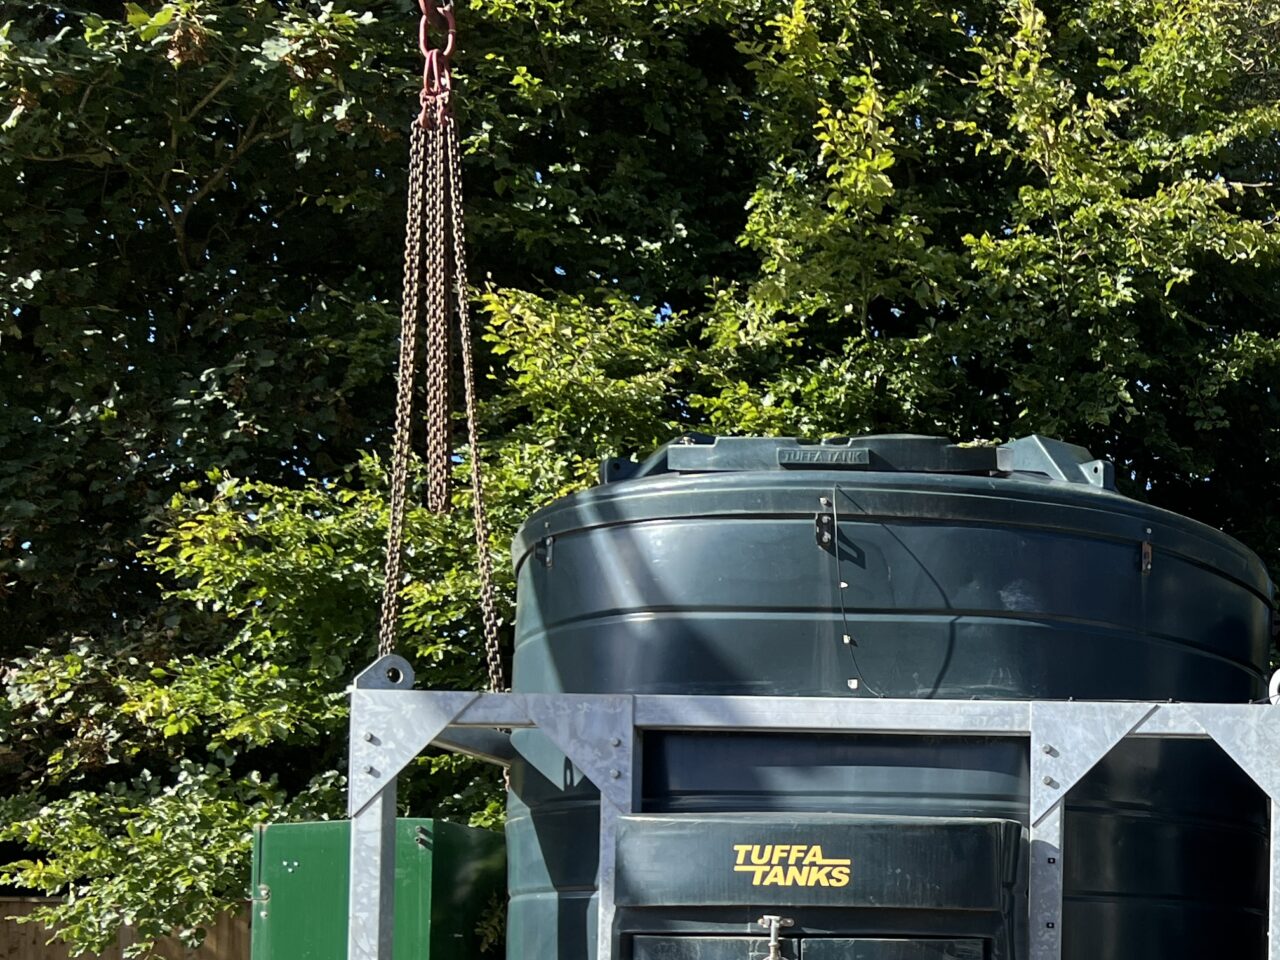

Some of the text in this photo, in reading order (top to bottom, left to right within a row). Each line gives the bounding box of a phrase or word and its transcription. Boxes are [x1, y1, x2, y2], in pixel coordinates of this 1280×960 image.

[783, 451, 863, 463] TUFFA TANK
[733, 844, 851, 865] TUFFA
[733, 865, 851, 887] TANKS
